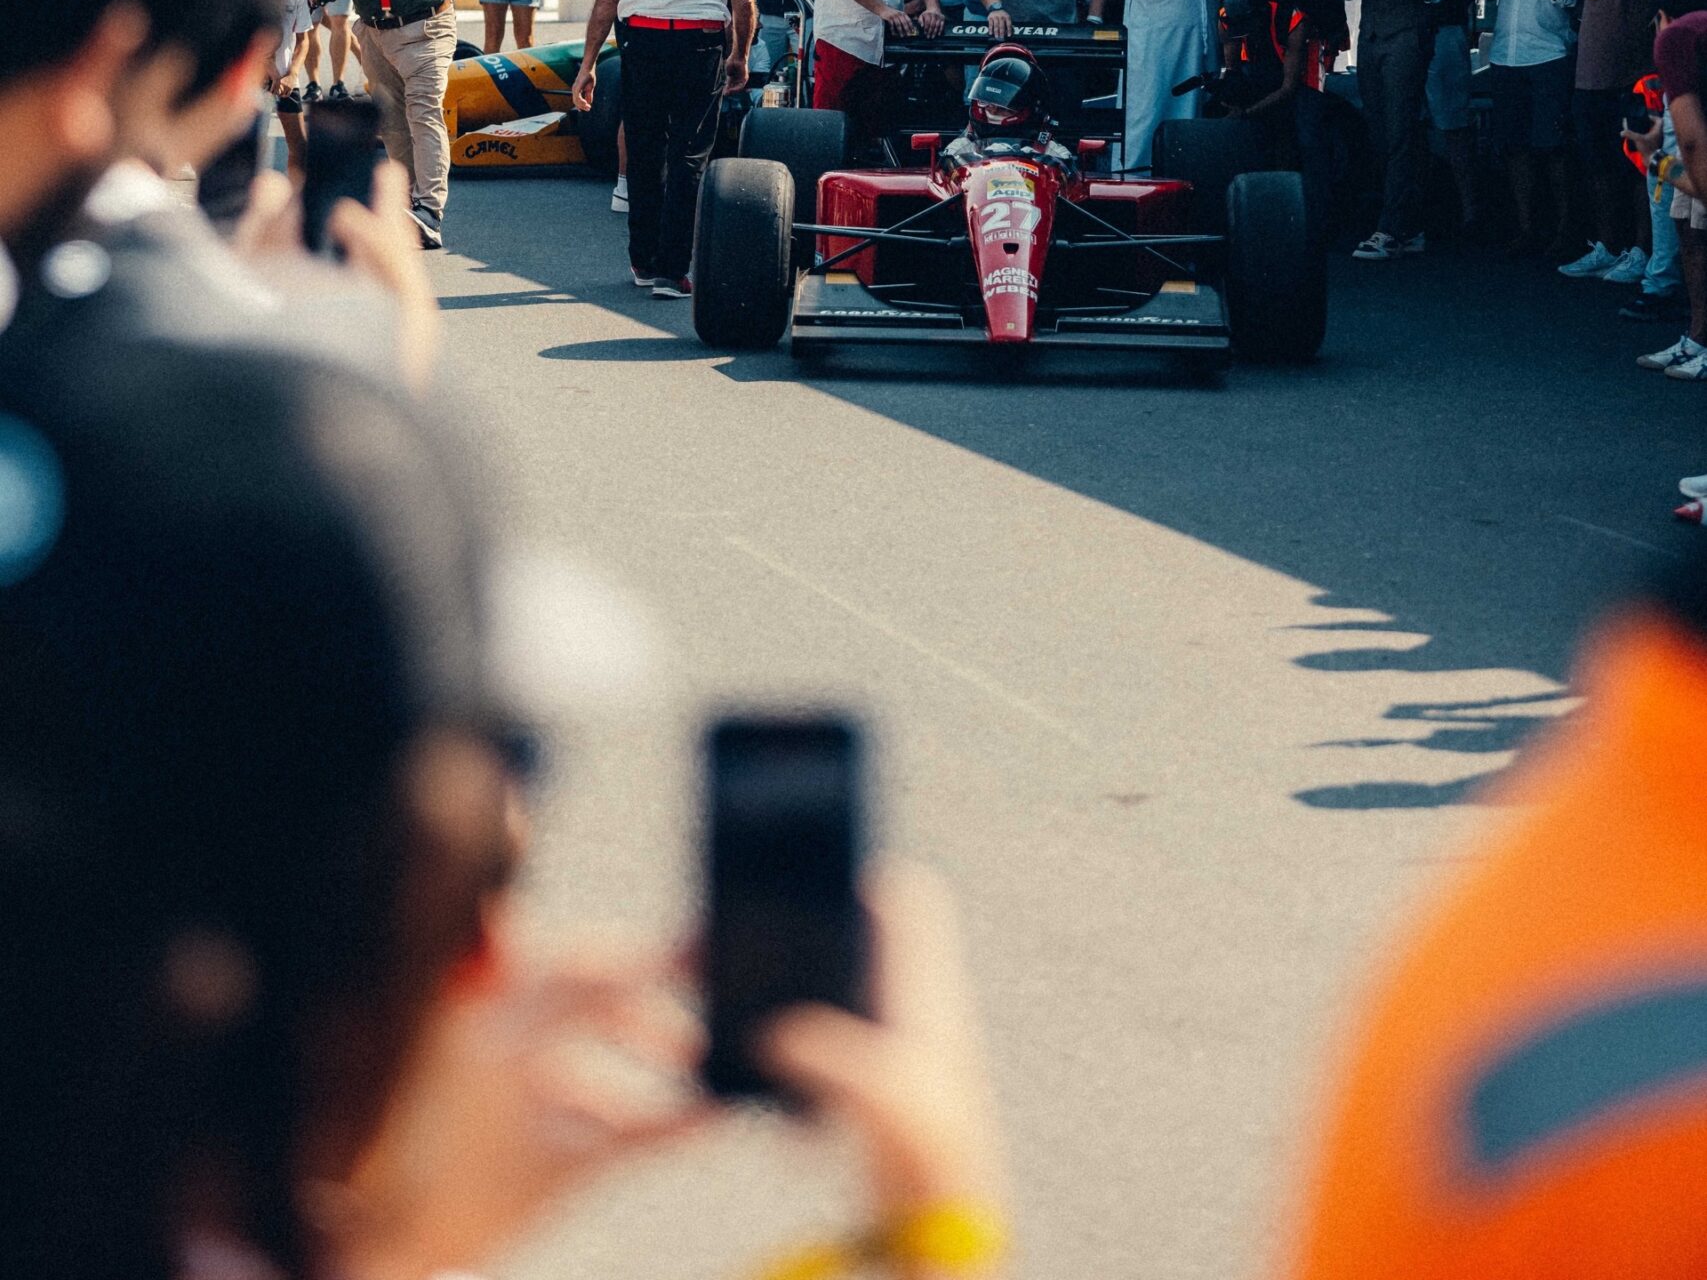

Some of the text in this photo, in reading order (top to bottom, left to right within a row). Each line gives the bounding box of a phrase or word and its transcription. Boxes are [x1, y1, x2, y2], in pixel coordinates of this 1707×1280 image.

[952, 25, 1059, 36] GOOYEAR
[464, 140, 519, 160] CAMEL
[991, 189, 1032, 199] Agip
[979, 201, 1041, 235] 27
[983, 285, 1039, 304] WEBER
